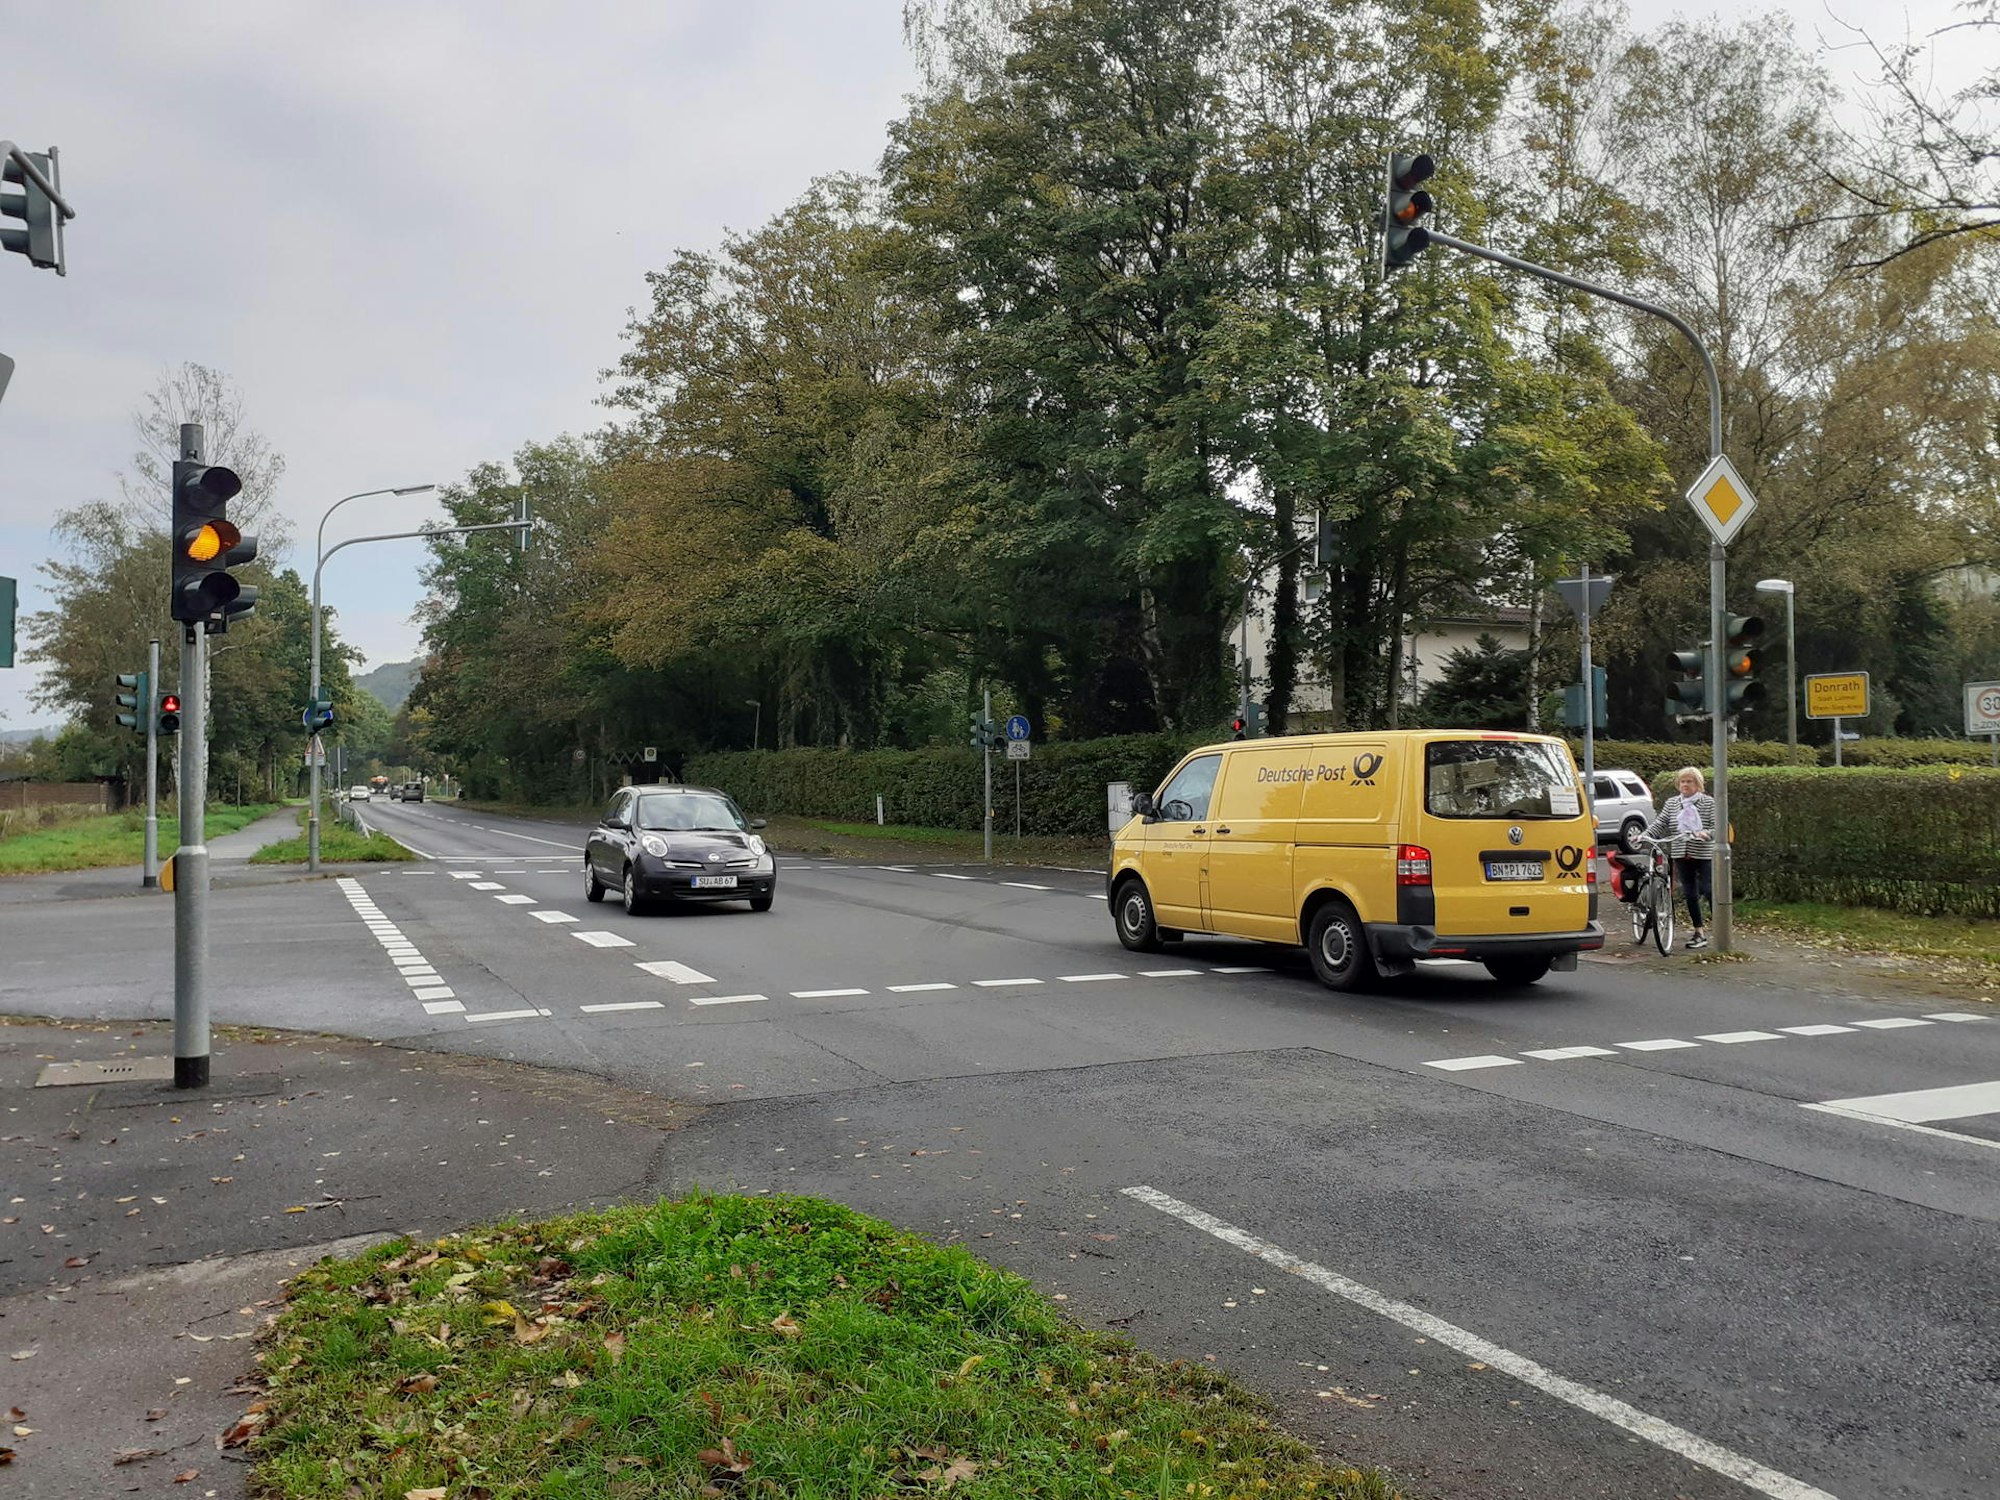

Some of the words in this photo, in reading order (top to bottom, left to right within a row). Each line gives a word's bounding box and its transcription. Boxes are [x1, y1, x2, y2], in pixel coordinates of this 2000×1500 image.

[1815, 681, 1860, 693] Donrath
[1983, 696, 2000, 711] 30
[1258, 765, 1313, 782] Deutsche
[1316, 764, 1346, 781] Post
[1492, 864, 1504, 876] BN
[699, 877, 709, 885] SU
[714, 877, 723, 885] AB
[724, 877, 734, 885] 67
